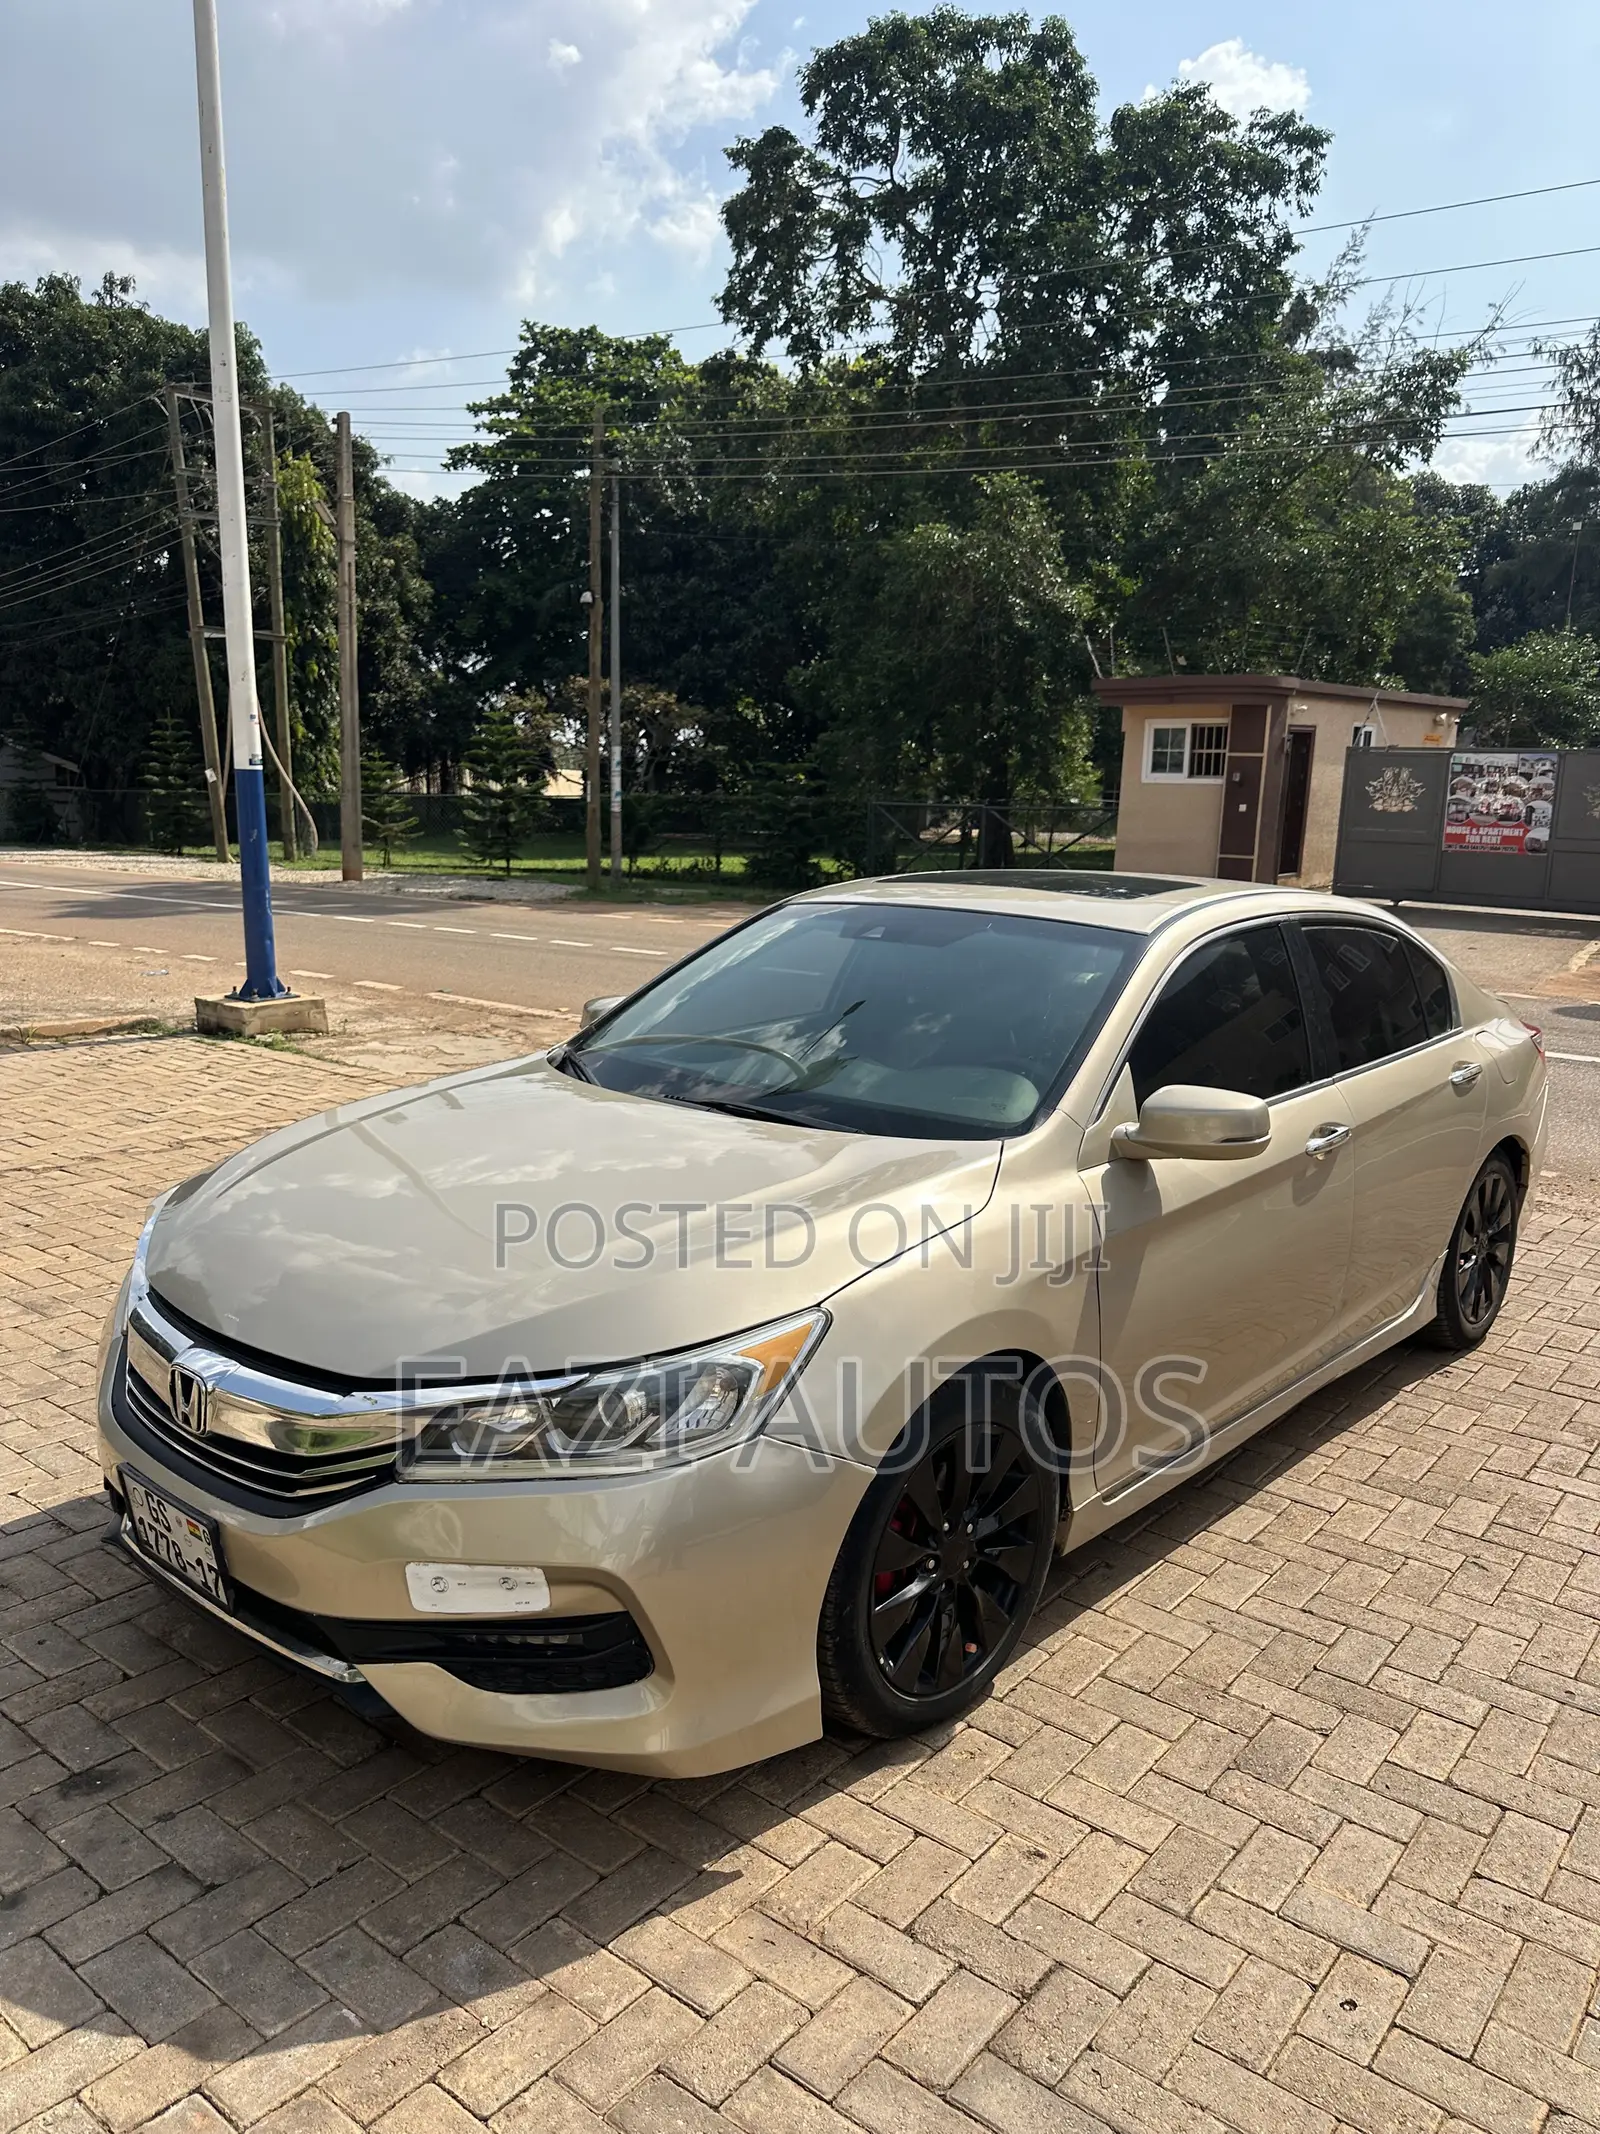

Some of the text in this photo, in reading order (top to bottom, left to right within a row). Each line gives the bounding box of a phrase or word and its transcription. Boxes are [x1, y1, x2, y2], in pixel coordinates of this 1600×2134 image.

[1446, 826, 1471, 834] HOUSE
[1478, 827, 1524, 836] APARTMENT
[1466, 835, 1501, 844] FOR RENT
[144, 1490, 172, 1533] GS
[138, 1516, 221, 1598] 1778-17
